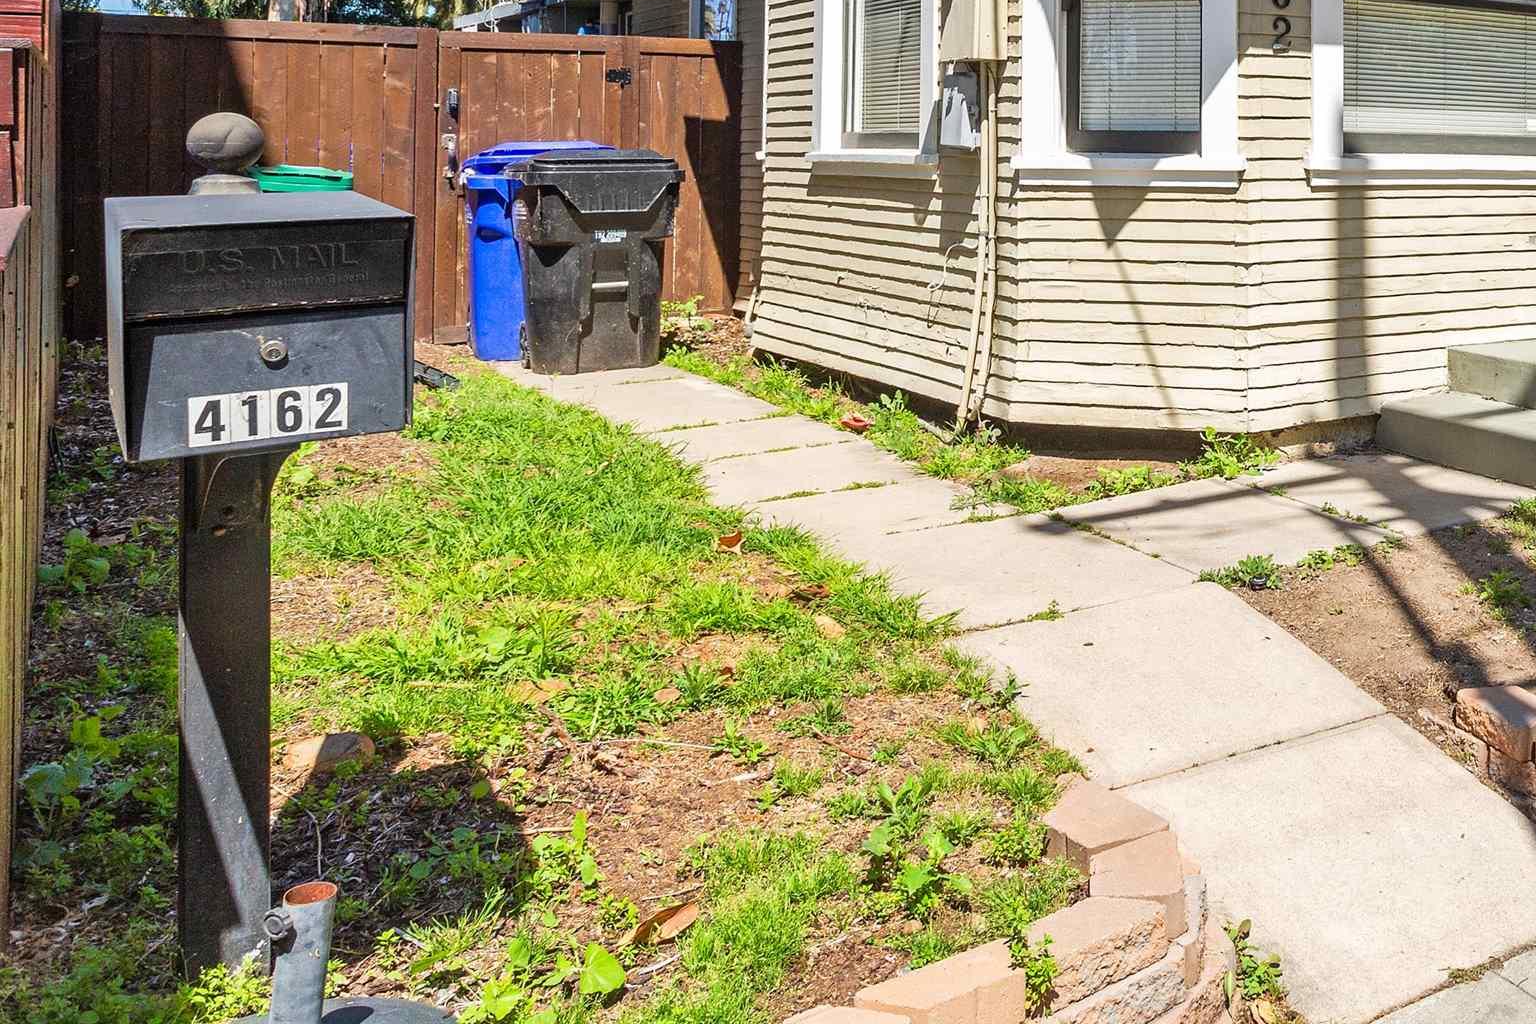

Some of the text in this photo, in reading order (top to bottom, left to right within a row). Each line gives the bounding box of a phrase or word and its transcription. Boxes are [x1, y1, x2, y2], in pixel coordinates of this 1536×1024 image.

[182, 242, 361, 274] U.S. MAIL
[194, 386, 343, 442] 4162
